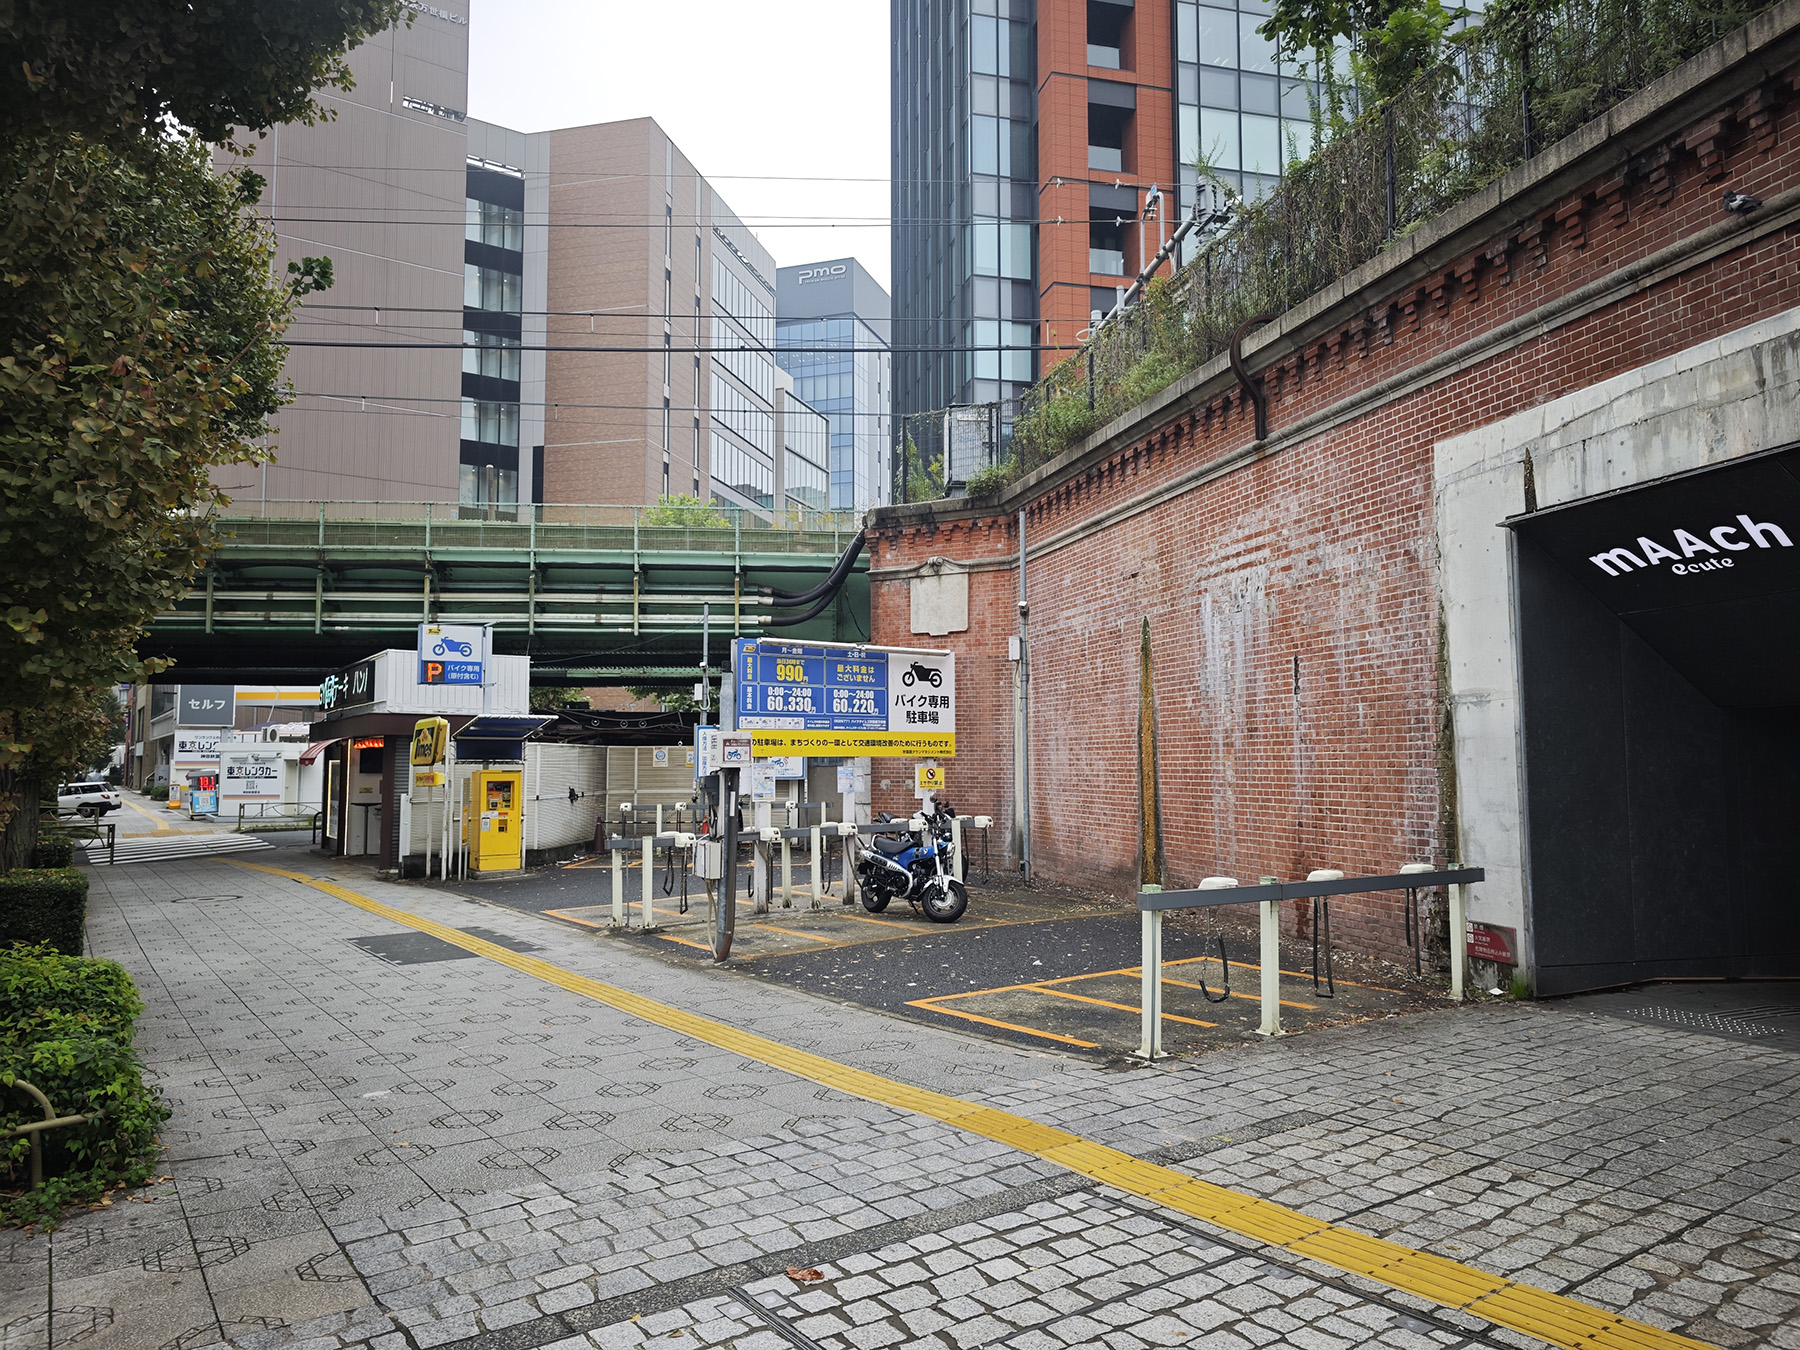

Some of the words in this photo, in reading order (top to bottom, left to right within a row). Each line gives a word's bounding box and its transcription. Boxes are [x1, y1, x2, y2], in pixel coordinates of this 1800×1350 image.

[1588, 514, 1794, 577] mAAch
[1671, 557, 1735, 576] ecute
[427, 662, 443, 682] P
[447, 664, 480, 673] バイク専用
[837, 664, 875, 674] 最大料金は
[836, 673, 876, 683] ございません
[188, 698, 226, 710] セルフ
[895, 693, 950, 709] バイク専用
[905, 710, 940, 725] 駐車場
[227, 766, 278, 776] 東京レンタカー
